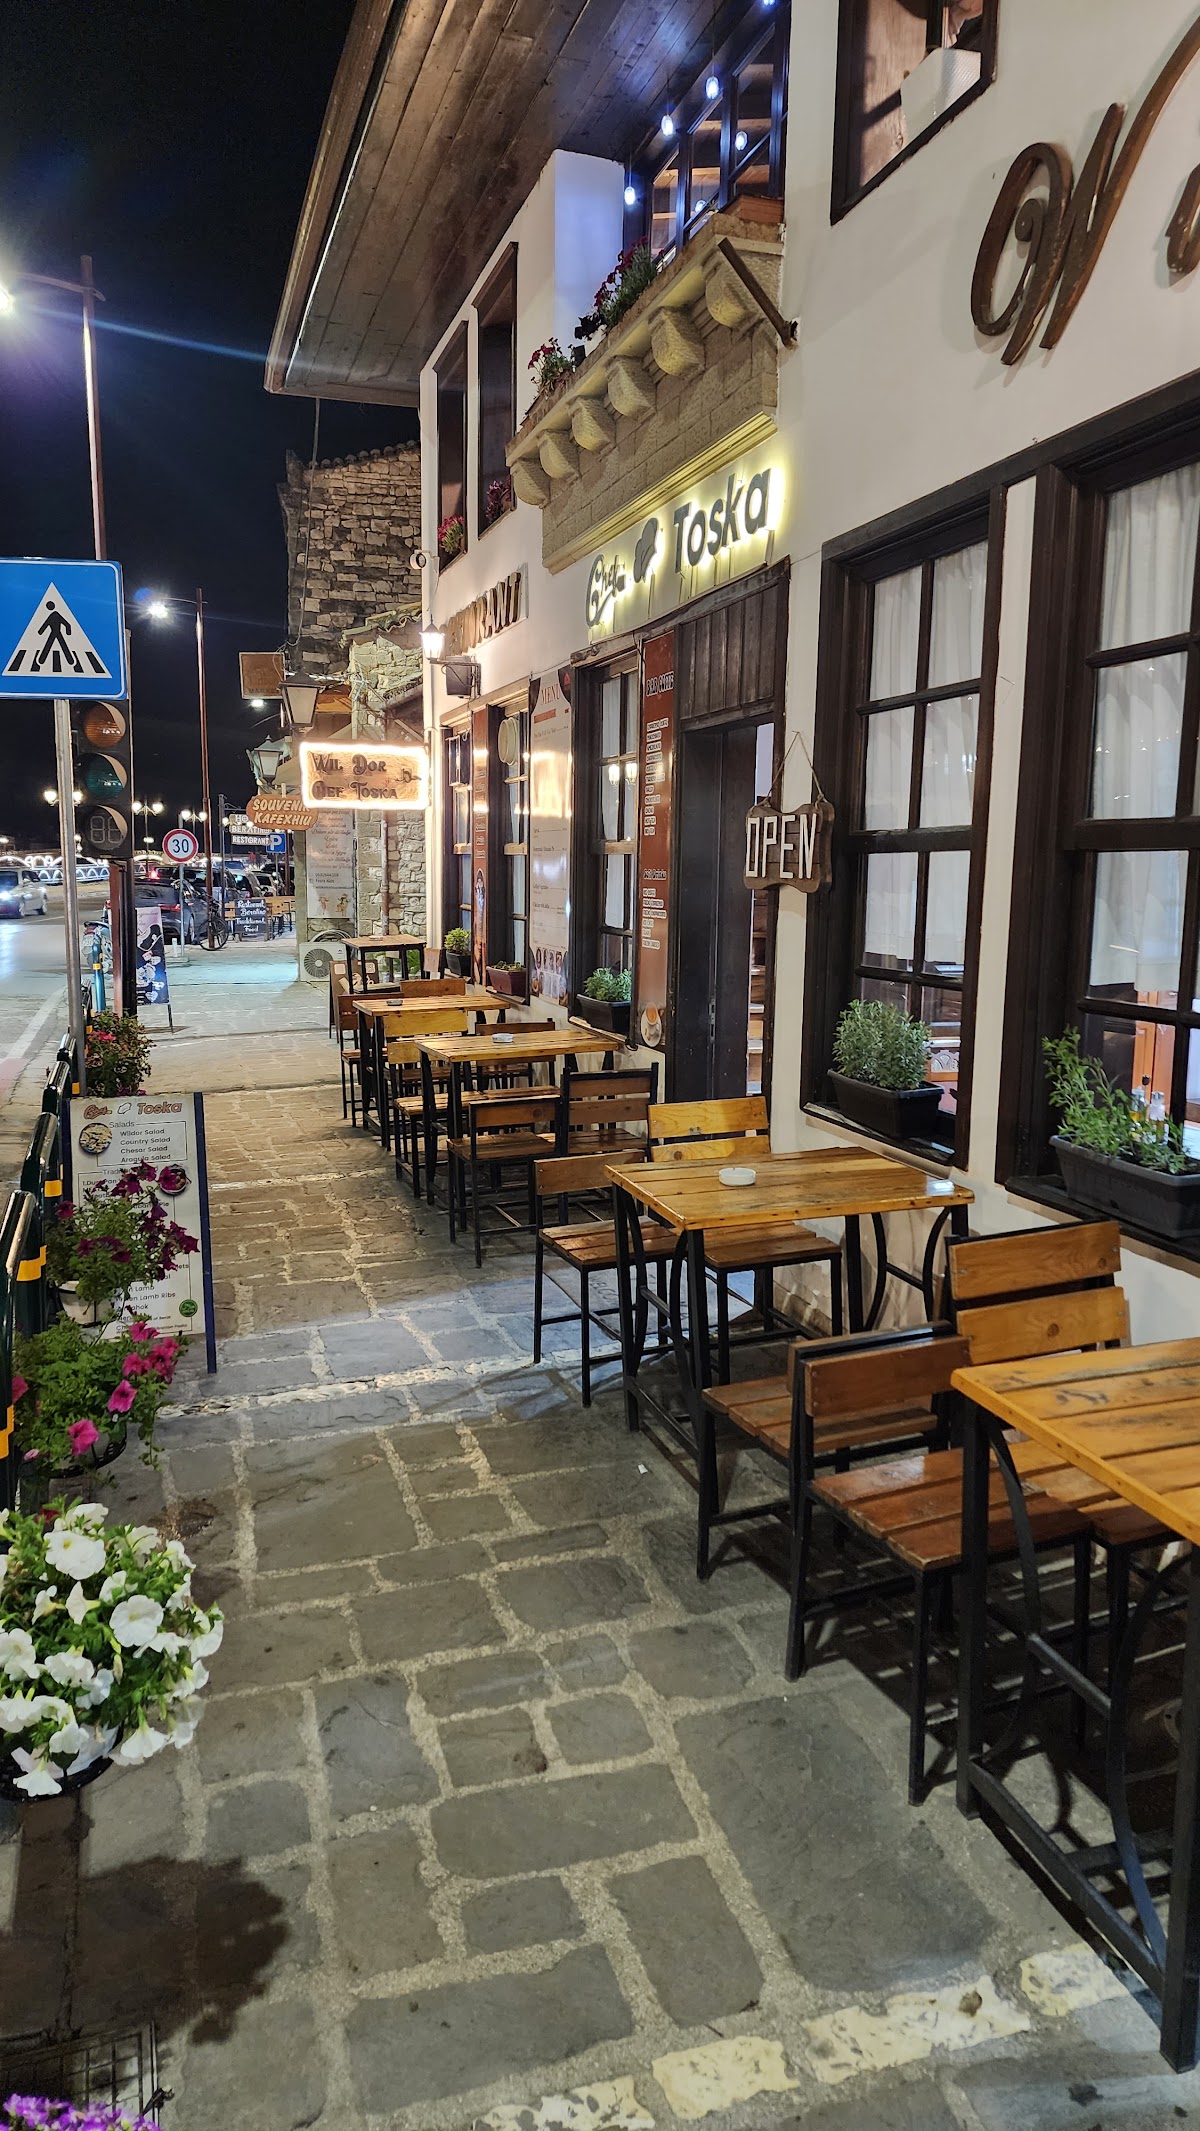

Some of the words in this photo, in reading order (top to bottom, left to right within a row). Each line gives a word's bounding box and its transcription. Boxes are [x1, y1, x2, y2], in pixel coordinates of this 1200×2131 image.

[674, 468, 771, 574] Toska
[541, 683, 561, 706] MENU
[254, 812, 312, 826] KAFEXHIU
[172, 839, 189, 853] 30
[232, 835, 270, 845] RESTORANT
[270, 835, 282, 850] P
[746, 813, 816, 879] OPEN
[137, 1101, 183, 1115] Toska
[120, 1138, 149, 1146] Country
